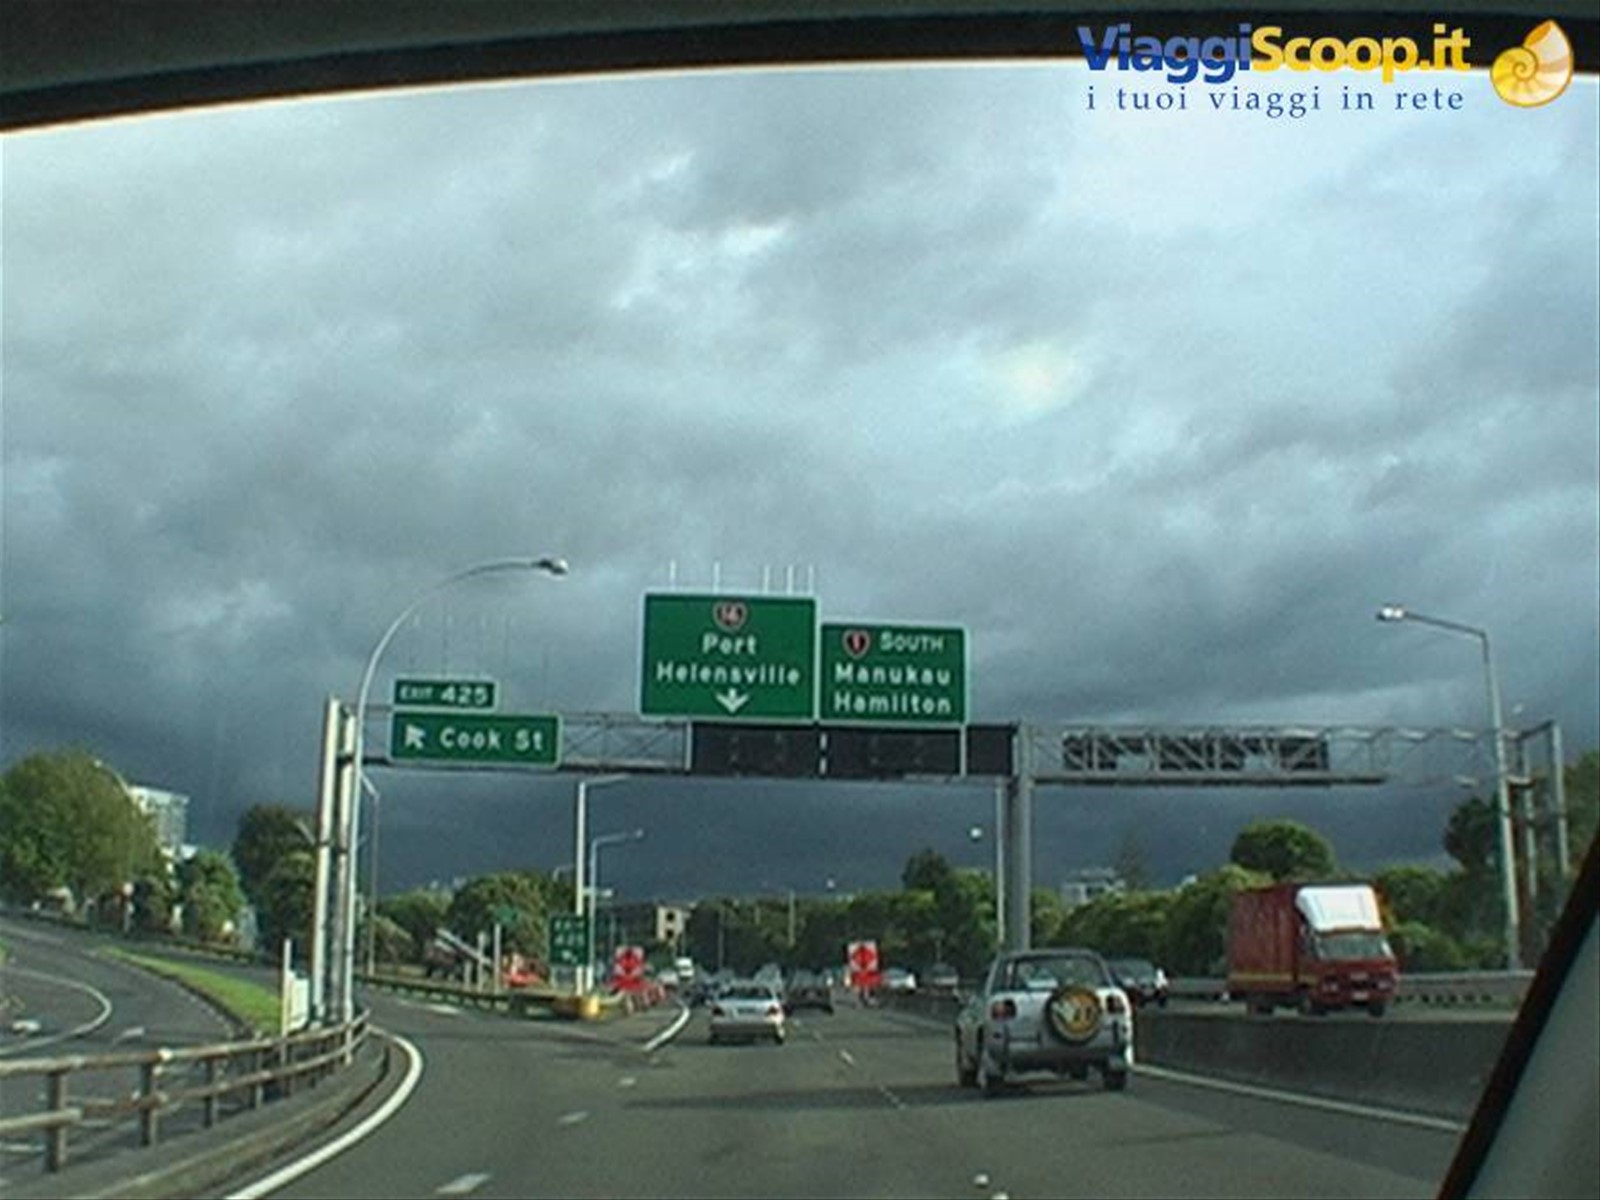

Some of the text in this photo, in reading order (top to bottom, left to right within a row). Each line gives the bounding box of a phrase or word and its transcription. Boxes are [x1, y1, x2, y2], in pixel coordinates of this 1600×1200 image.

[703, 632, 757, 655] Port
[656, 660, 800, 685] Helensville
[835, 661, 951, 686] Manukau
[440, 685, 488, 705] 425
[834, 690, 952, 715] Hamilton
[439, 727, 543, 751] Cook St
